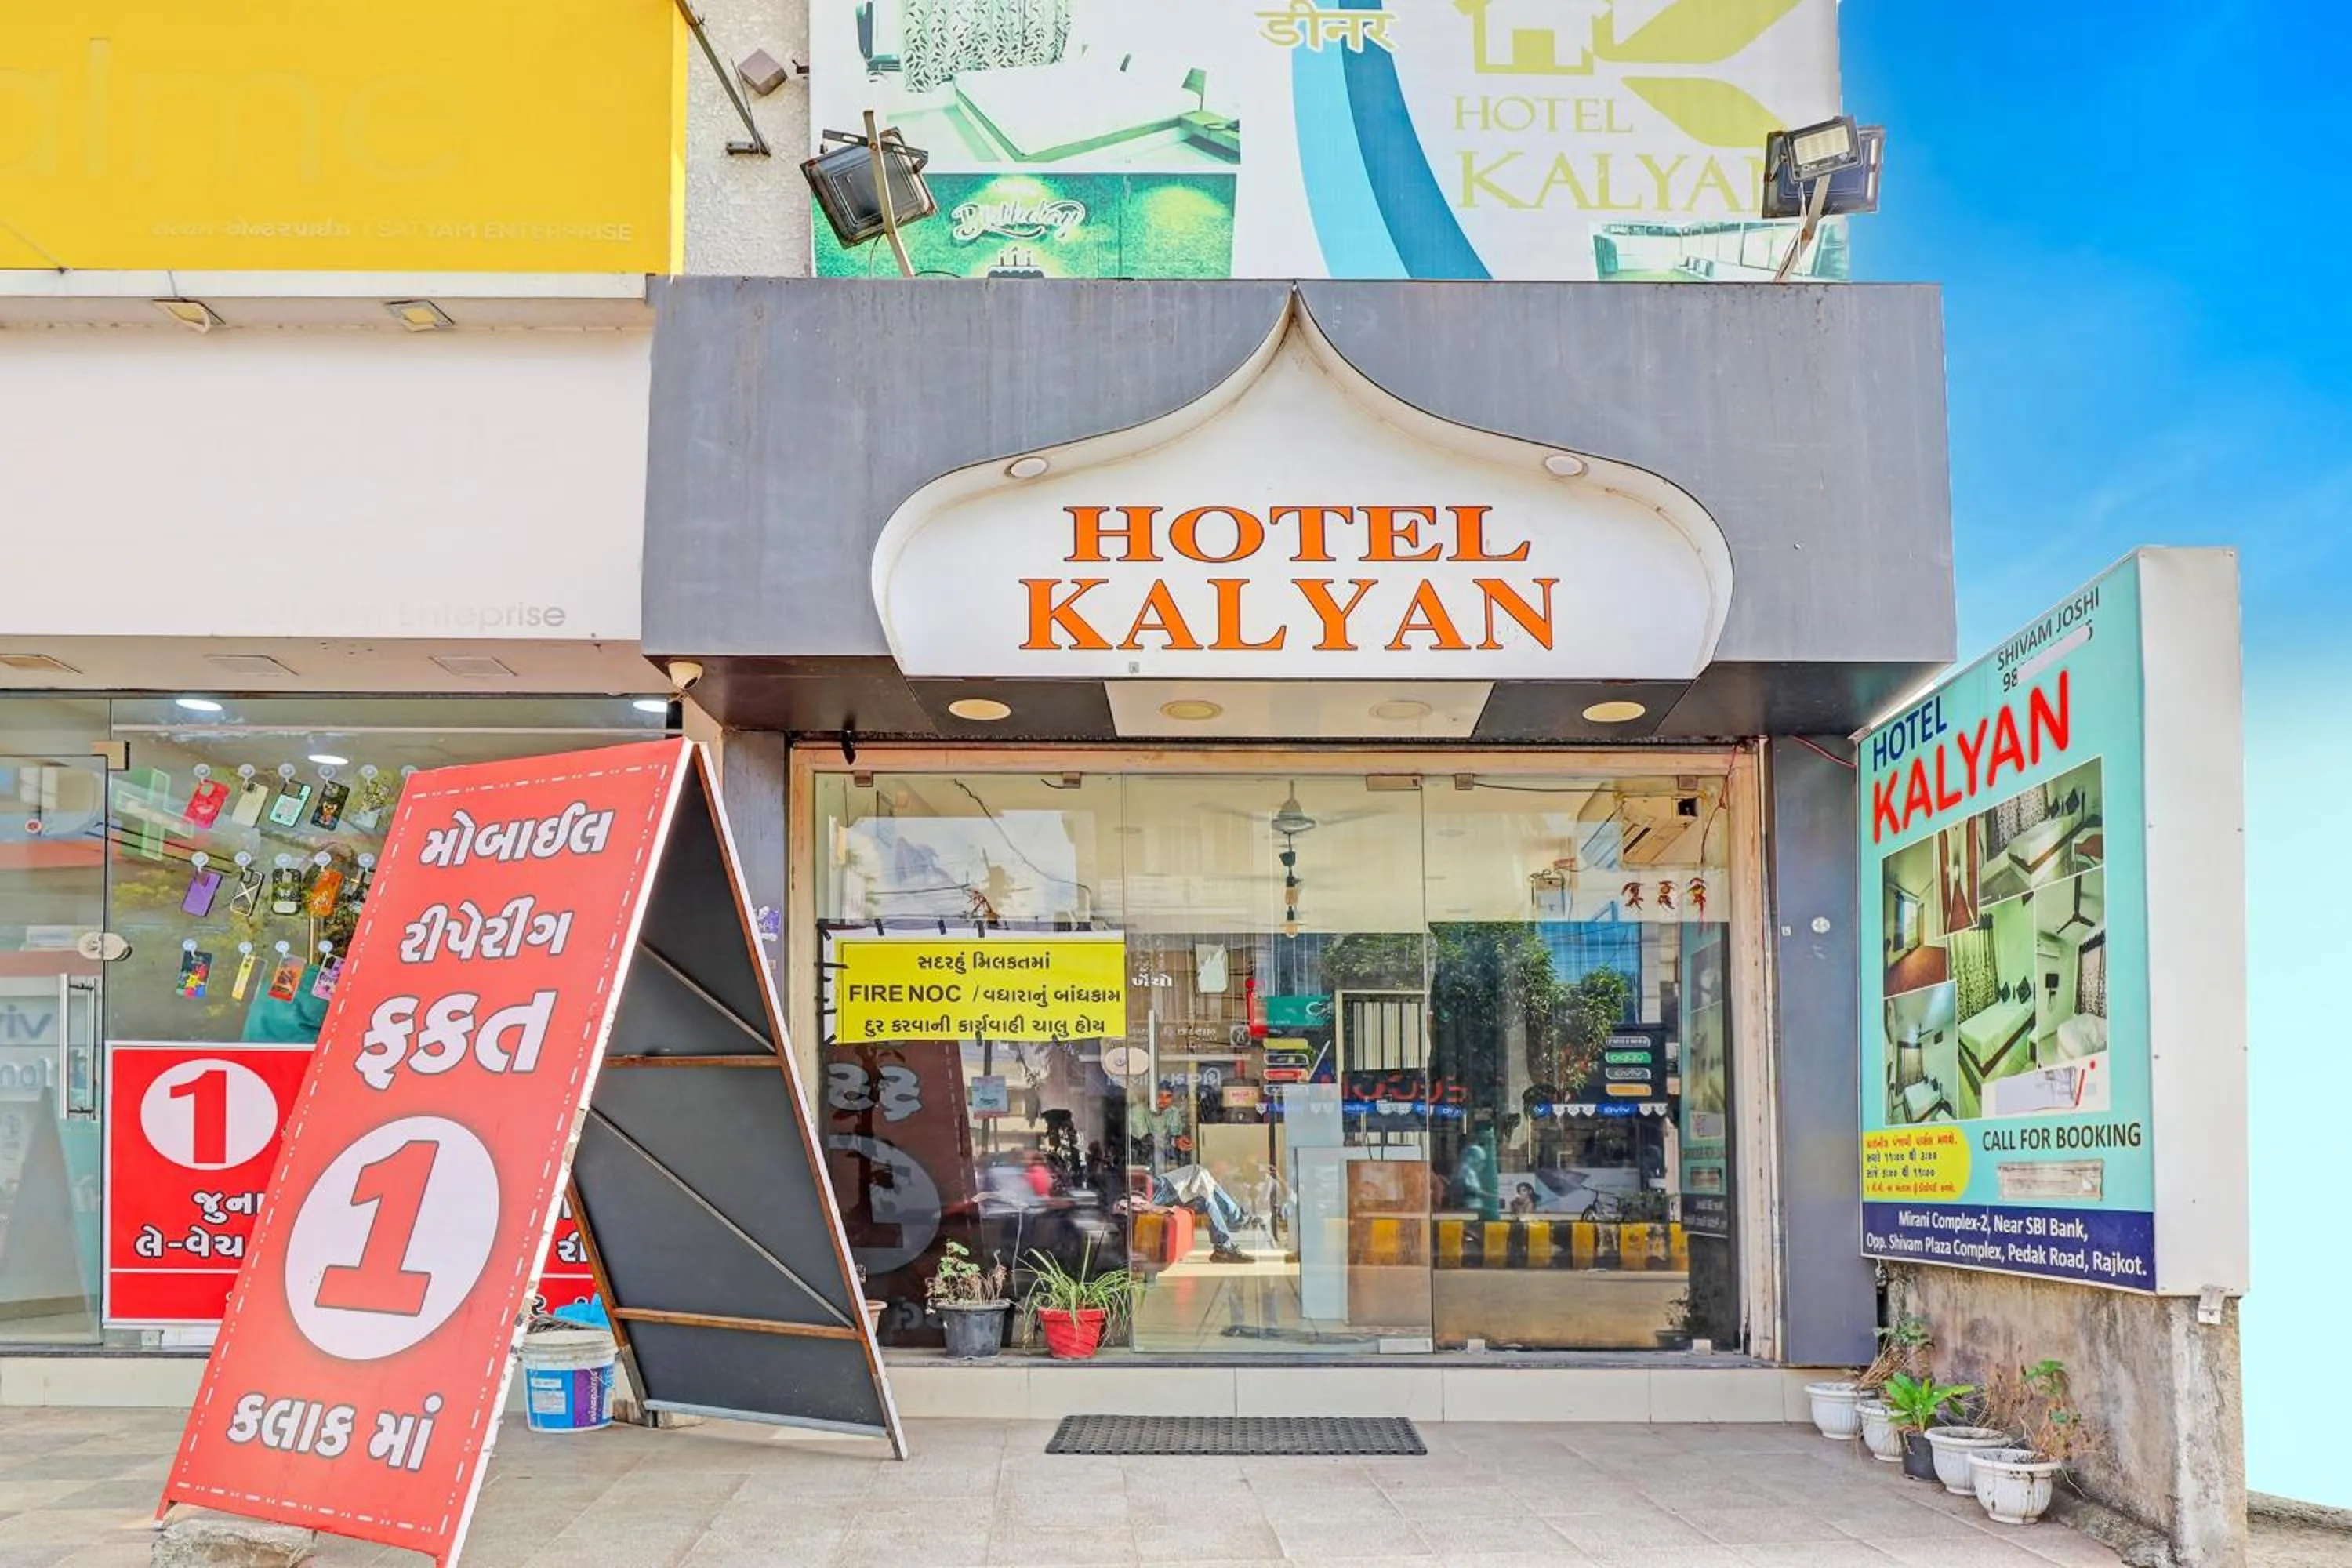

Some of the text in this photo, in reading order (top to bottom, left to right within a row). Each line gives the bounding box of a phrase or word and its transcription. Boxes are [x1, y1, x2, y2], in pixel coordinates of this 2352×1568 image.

[1254, 0, 1398, 54] डीनर
[1454, 96, 1634, 135] HOTEL
[1063, 505, 1531, 563] HOTEL
[1019, 578, 1559, 651] KALYAN
[1998, 619, 2053, 671] SHIVAM
[2056, 586, 2099, 633] JOSHI
[1872, 695, 1947, 772] HOTEL
[1872, 669, 2070, 844] KALYAN
[419, 801, 615, 868] મોબાઈલ
[973, 951, 1050, 970] મિલકતમાં
[849, 984, 903, 1002] FIRE
[909, 984, 961, 1003] NOC
[983, 984, 1048, 1007] વધારાનું
[1054, 984, 1120, 1003] બાંધકામ
[891, 1014, 950, 1033] કરવાની
[1032, 1019, 1069, 1037] ચાલુ
[1075, 1014, 1105, 1033] હોય
[353, 989, 558, 1091] ફકત
[169, 1069, 227, 1164] 1
[1983, 1122, 2141, 1152] CALL FOR BOOKING
[314, 1140, 440, 1317] 1
[1866, 1232, 2147, 1277] Opp. Shivam Plaza Complex, Pedak Road, Rajkot.
[1898, 1210, 2089, 1243] Mirani Complex-2, Near SBI Bank,
[226, 1392, 445, 1472] કલાક માં
